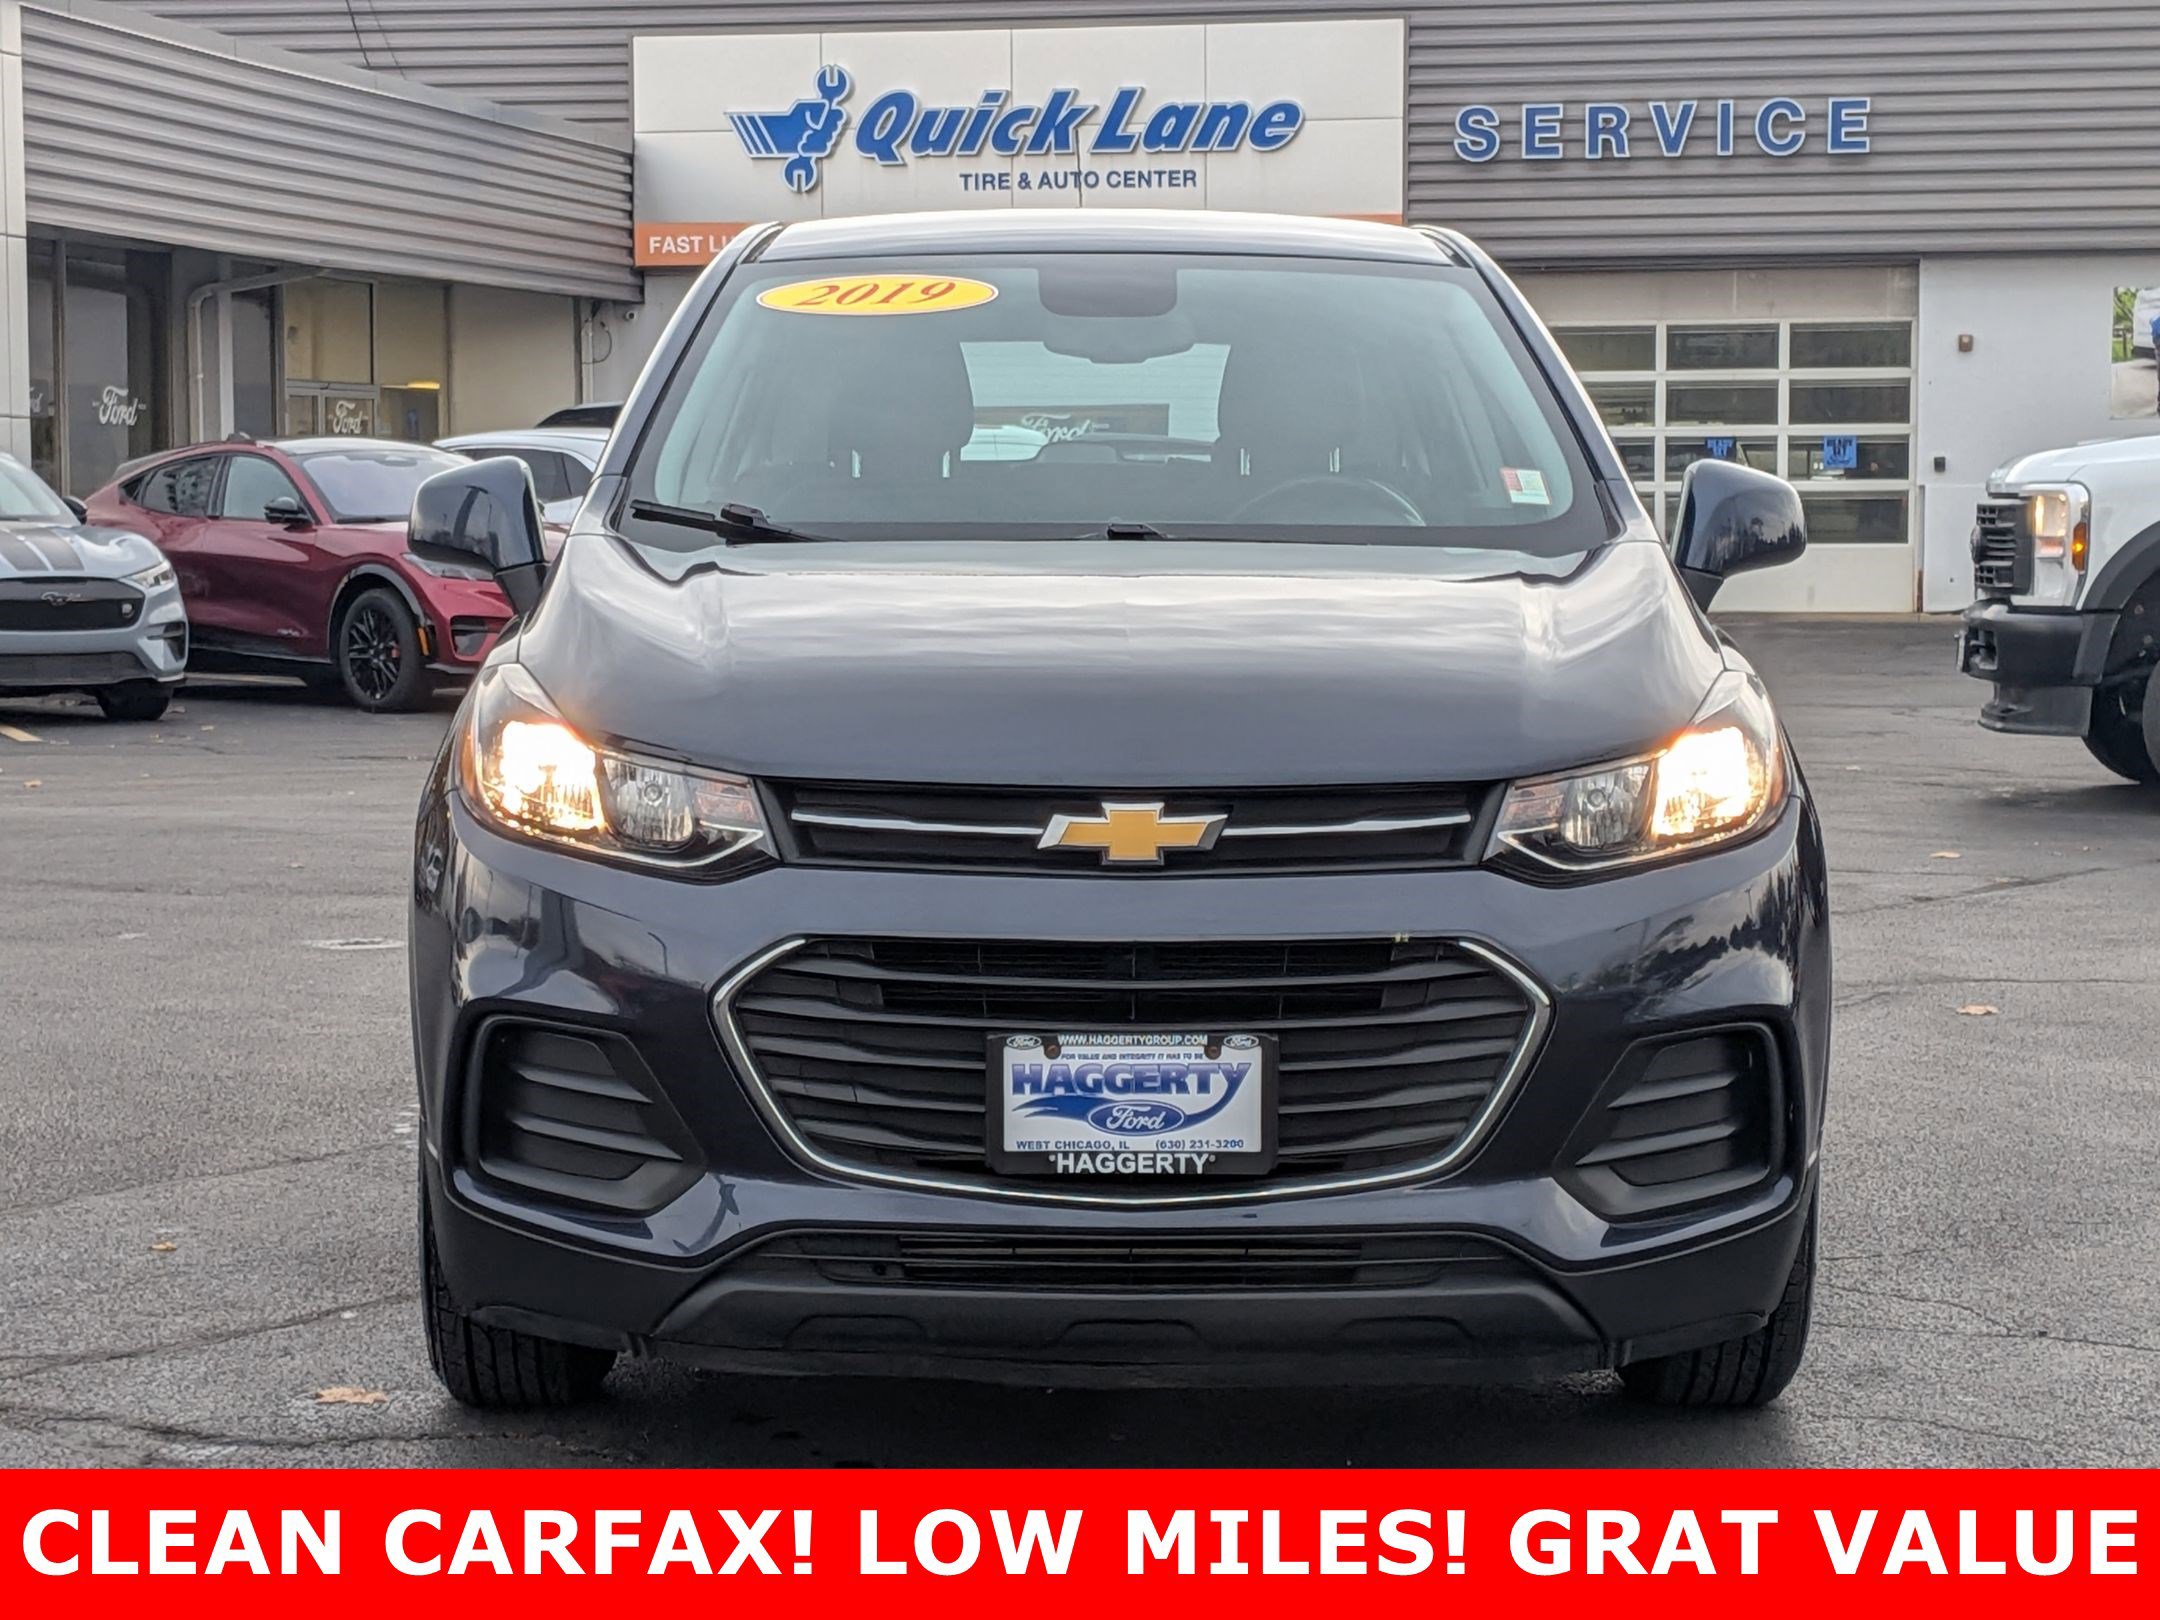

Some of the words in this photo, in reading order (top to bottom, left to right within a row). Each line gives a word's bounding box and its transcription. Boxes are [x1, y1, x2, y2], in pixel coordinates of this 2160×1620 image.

[855, 87, 1099, 166] Quick
[1090, 86, 1305, 154] Lane
[1453, 97, 1871, 163] SERVICE
[959, 172, 1011, 192] TIRE
[1017, 173, 1032, 190] &
[1038, 171, 1100, 190] AUTO
[1106, 169, 1197, 189] CENTER
[649, 236, 703, 254] FAST
[793, 281, 956, 307] 2019
[99, 385, 138, 425] Ford
[333, 400, 363, 434] Ford
[1057, 1034, 1208, 1046] WWW.HAGGERTYGROUP.COM
[1011, 1063, 1252, 1096] HAGGERTY
[1106, 1104, 1165, 1130] Ford
[1016, 1140, 1050, 1150] WEST
[1055, 1140, 1115, 1151] CHICAGO,
[1119, 1140, 1130, 1149] IL
[1155, 1139, 1186, 1151] (630)
[1189, 1139, 1244, 1149] 231-3200
